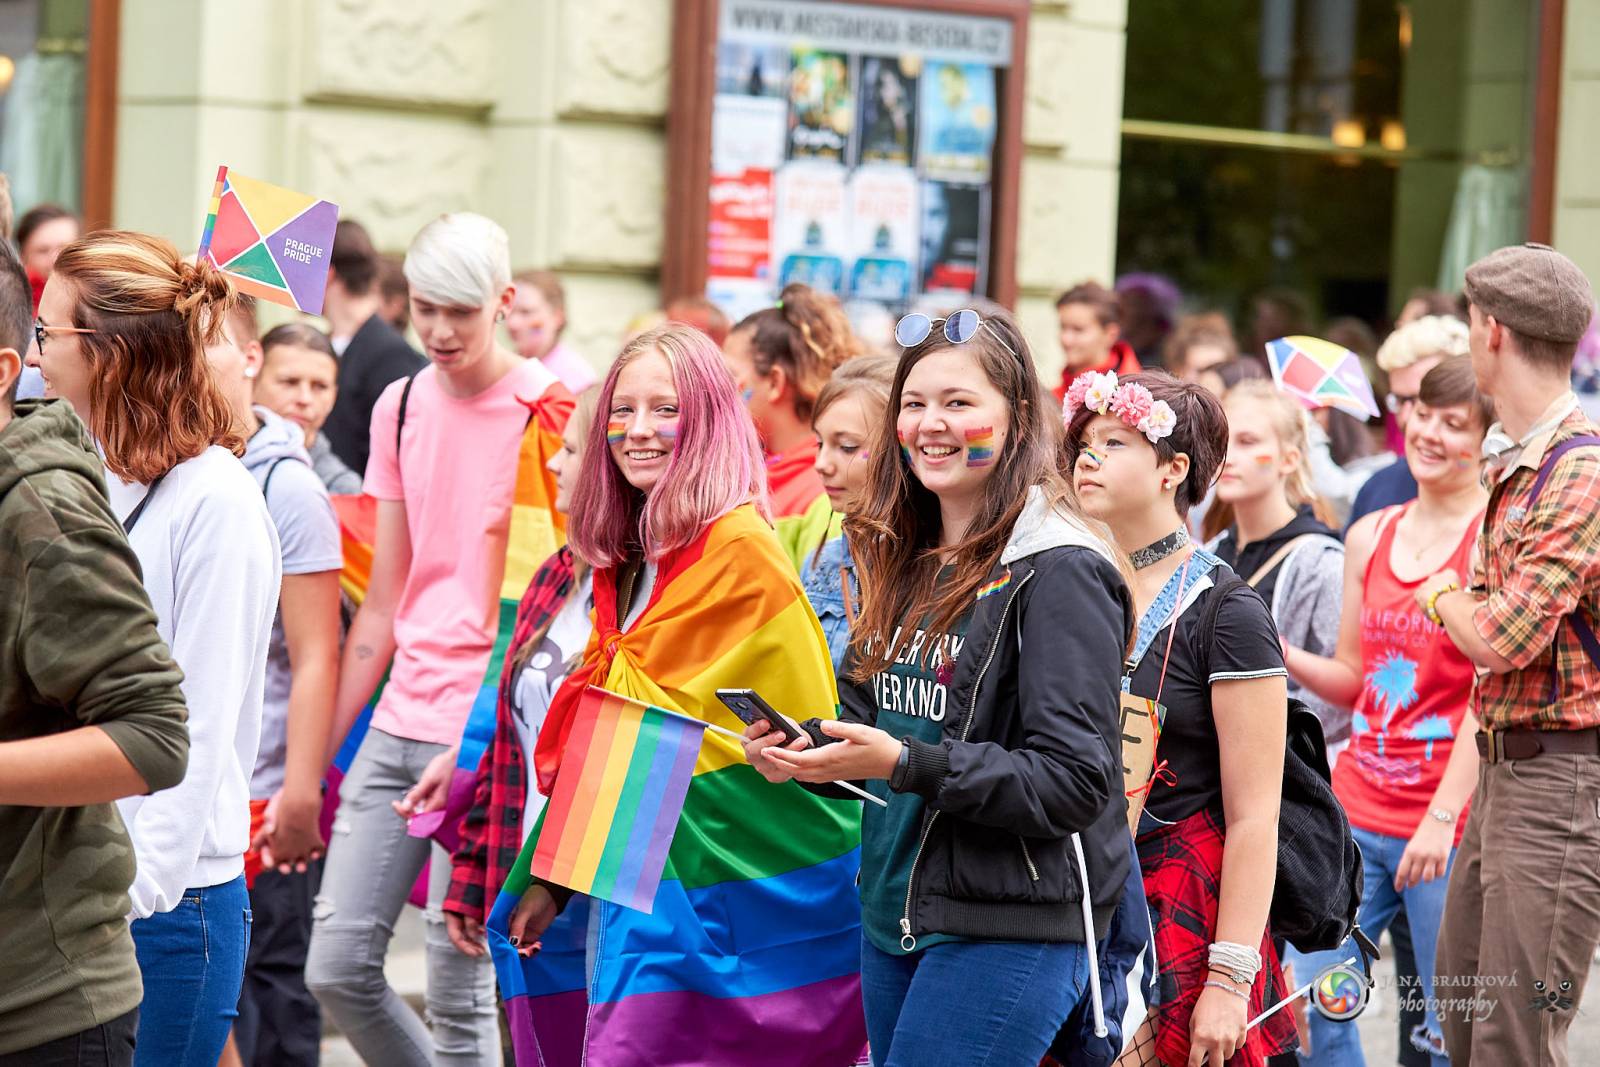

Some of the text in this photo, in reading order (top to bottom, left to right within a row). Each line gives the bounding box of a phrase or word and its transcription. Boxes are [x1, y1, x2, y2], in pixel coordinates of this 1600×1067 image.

[283, 247, 312, 265] PRIDE
[285, 237, 323, 258] PRAGUE
[872, 670, 948, 722] VER KNO
